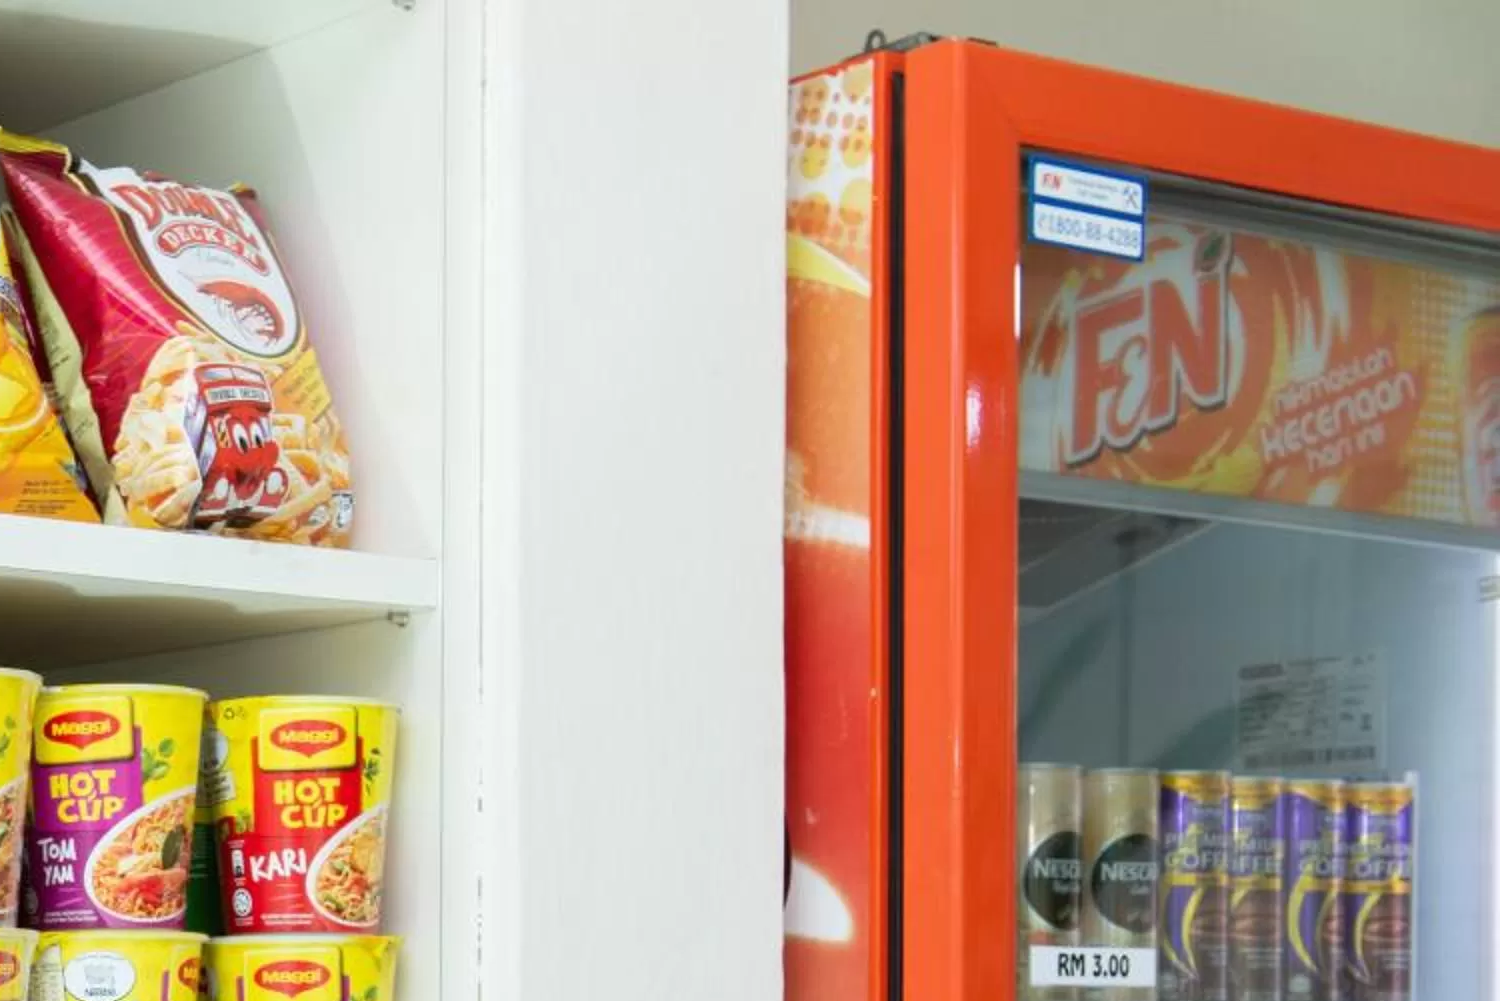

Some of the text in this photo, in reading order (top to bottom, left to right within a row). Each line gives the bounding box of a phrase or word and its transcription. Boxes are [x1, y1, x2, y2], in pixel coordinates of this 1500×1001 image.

[1066, 270, 1231, 468] F&N
[49, 769, 117, 799] HOT
[272, 777, 341, 805] HOT
[57, 796, 125, 824] CUP
[280, 803, 347, 829] CUP
[37, 837, 78, 864] TOM
[43, 864, 75, 888] YAM
[249, 847, 308, 883] KARI
[1057, 952, 1130, 978] RM 3.00
